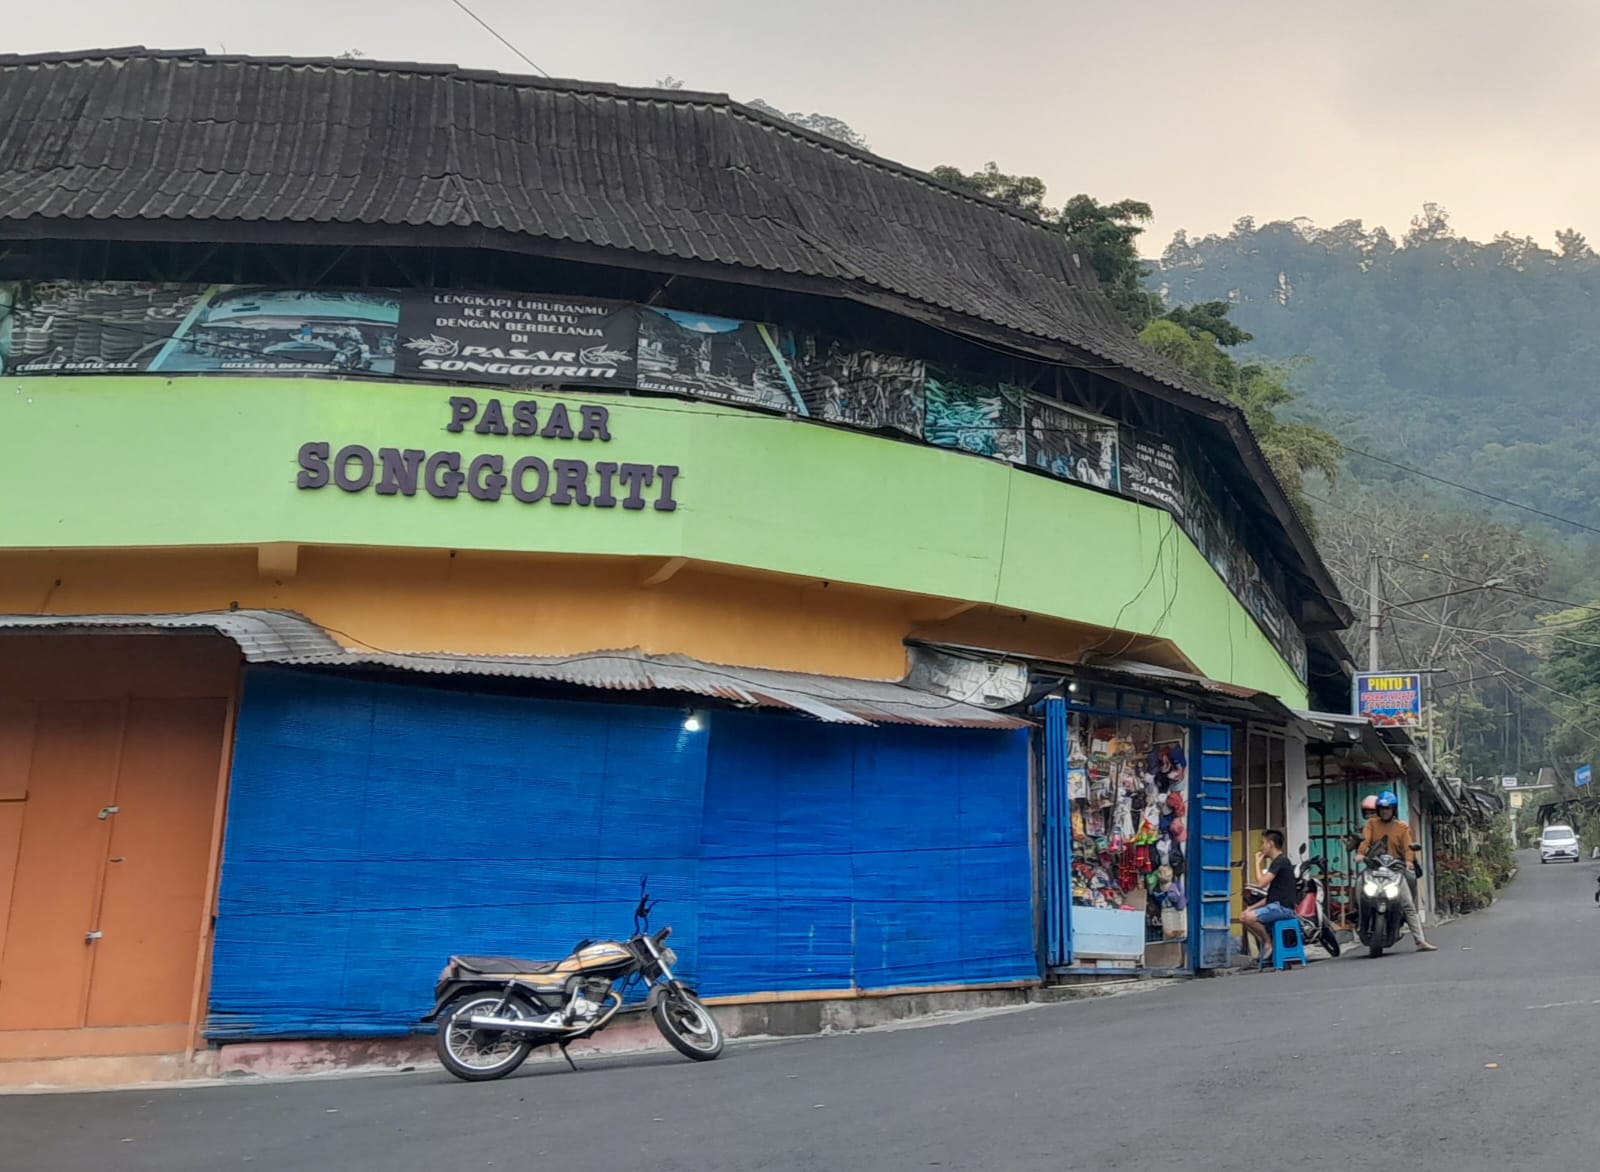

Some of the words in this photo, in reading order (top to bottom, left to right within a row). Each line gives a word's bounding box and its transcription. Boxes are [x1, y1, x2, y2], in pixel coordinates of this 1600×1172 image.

[434, 295, 512, 309] LENGKAPI
[517, 299, 609, 316] LIBURANMU
[464, 307, 484, 317] KE
[490, 310, 532, 322] KOTA
[537, 313, 578, 325] BATU
[436, 318, 500, 330] DENGAN
[505, 322, 604, 337] BERBELANJA
[511, 334, 529, 344] DI
[461, 345, 578, 362] PASAR
[418, 358, 618, 378] SONGGORITI
[639, 382, 687, 393] WISATA
[446, 395, 612, 442] PASAR
[296, 440, 681, 512] SONGGORITI
[1367, 676, 1403, 691] PINTU
[1405, 676, 1412, 690] 1
